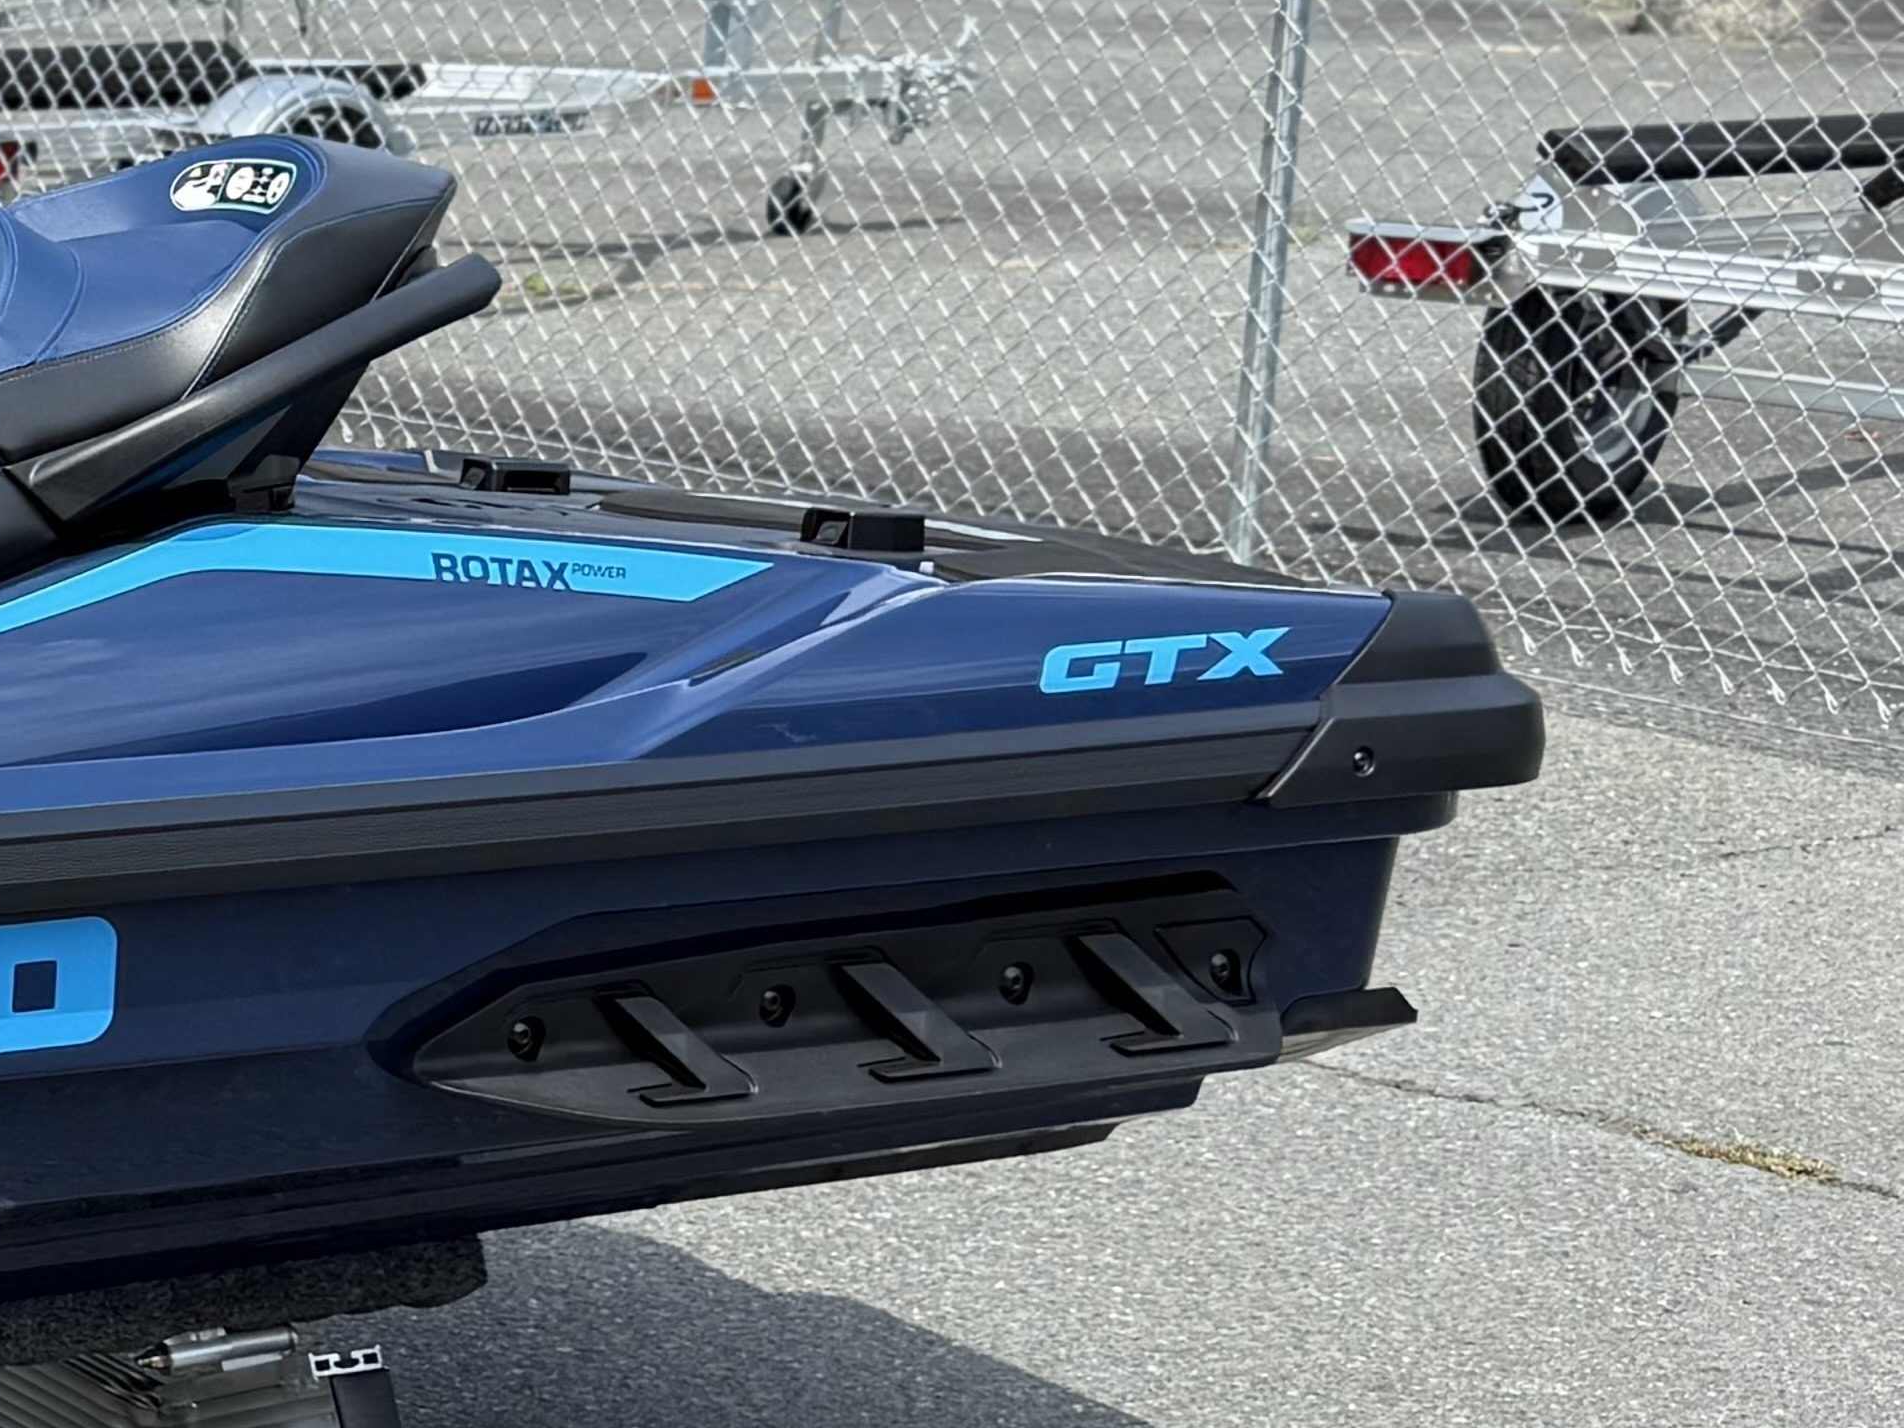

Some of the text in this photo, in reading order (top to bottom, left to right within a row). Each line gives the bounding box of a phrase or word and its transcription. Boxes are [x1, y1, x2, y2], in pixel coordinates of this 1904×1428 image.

[431, 552, 626, 592] ROTAX POWER
[1038, 626, 1294, 694] GTX
